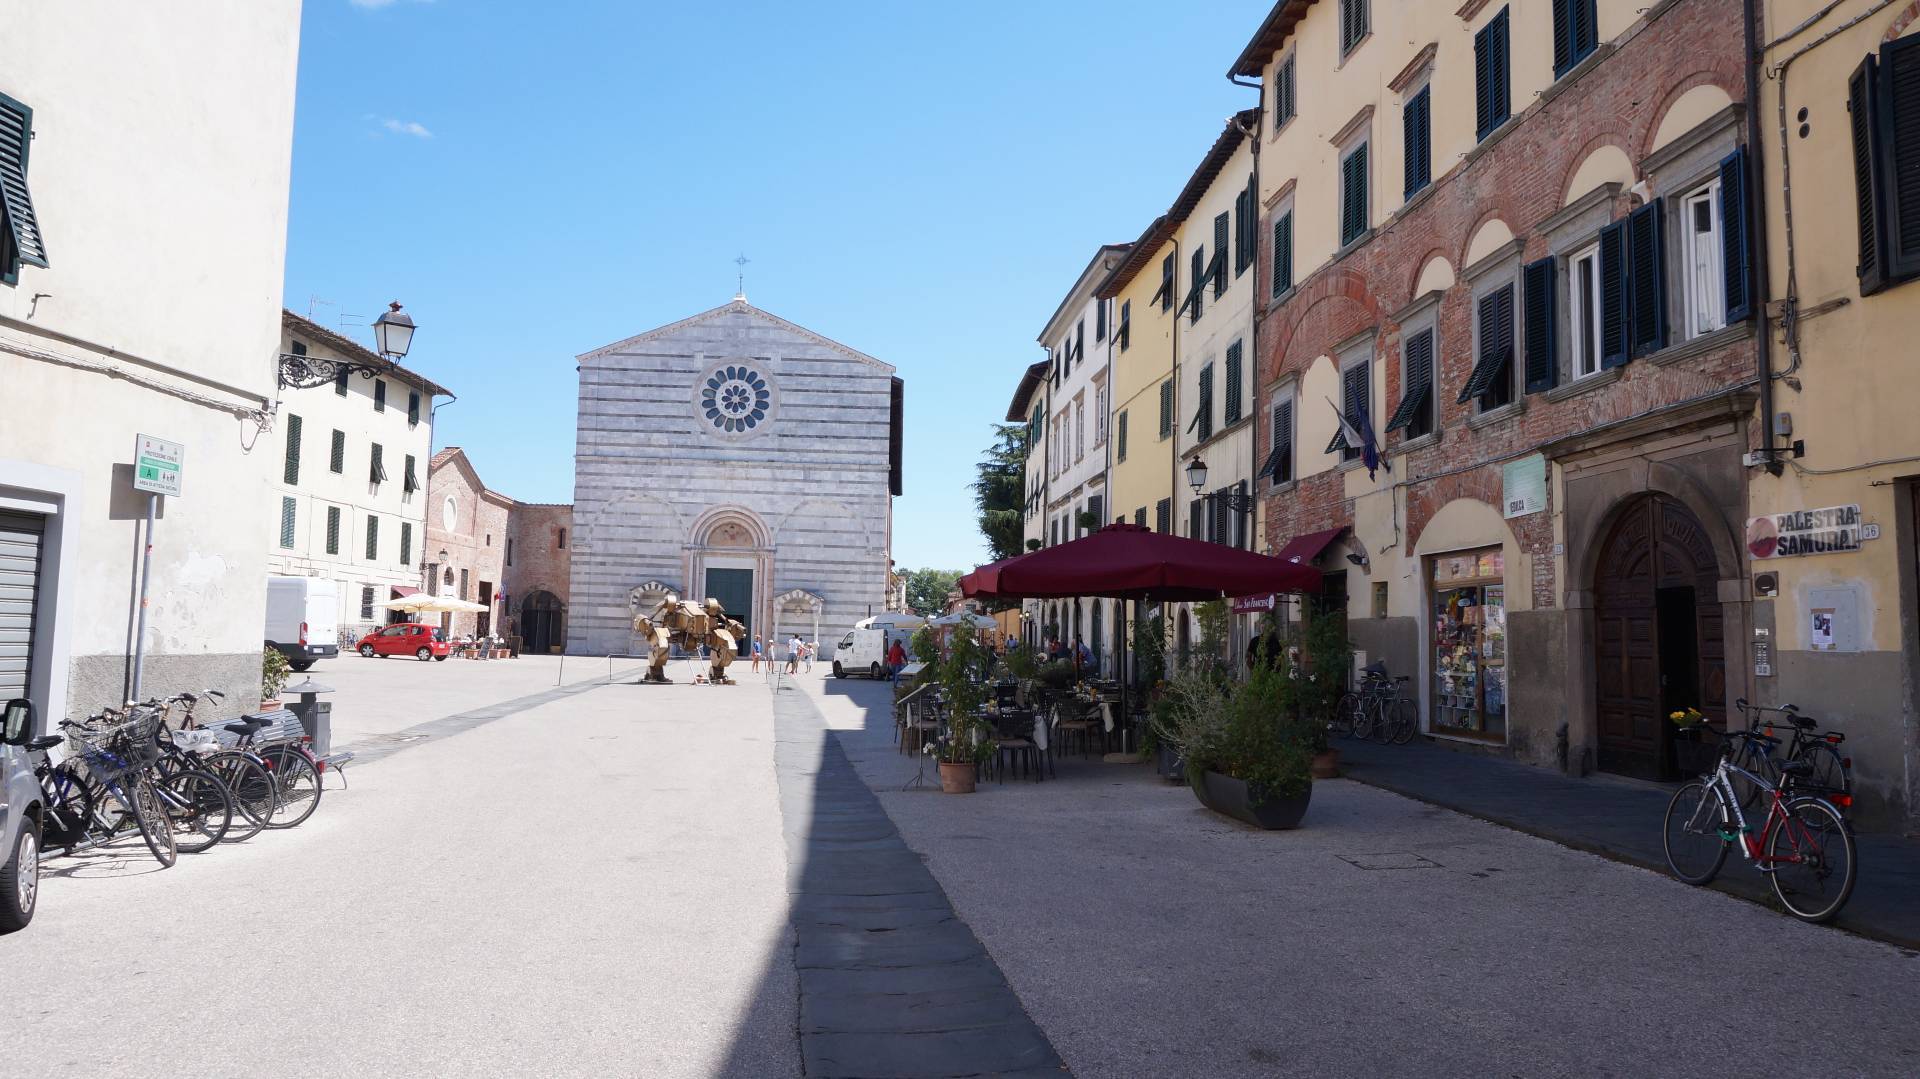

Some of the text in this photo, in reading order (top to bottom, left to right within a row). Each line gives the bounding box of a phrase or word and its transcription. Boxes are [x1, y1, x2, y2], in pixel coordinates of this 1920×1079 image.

[147, 468, 152, 479] A
[1777, 507, 1856, 533] PALESTRA
[1778, 529, 1857, 556] SAMURAI
